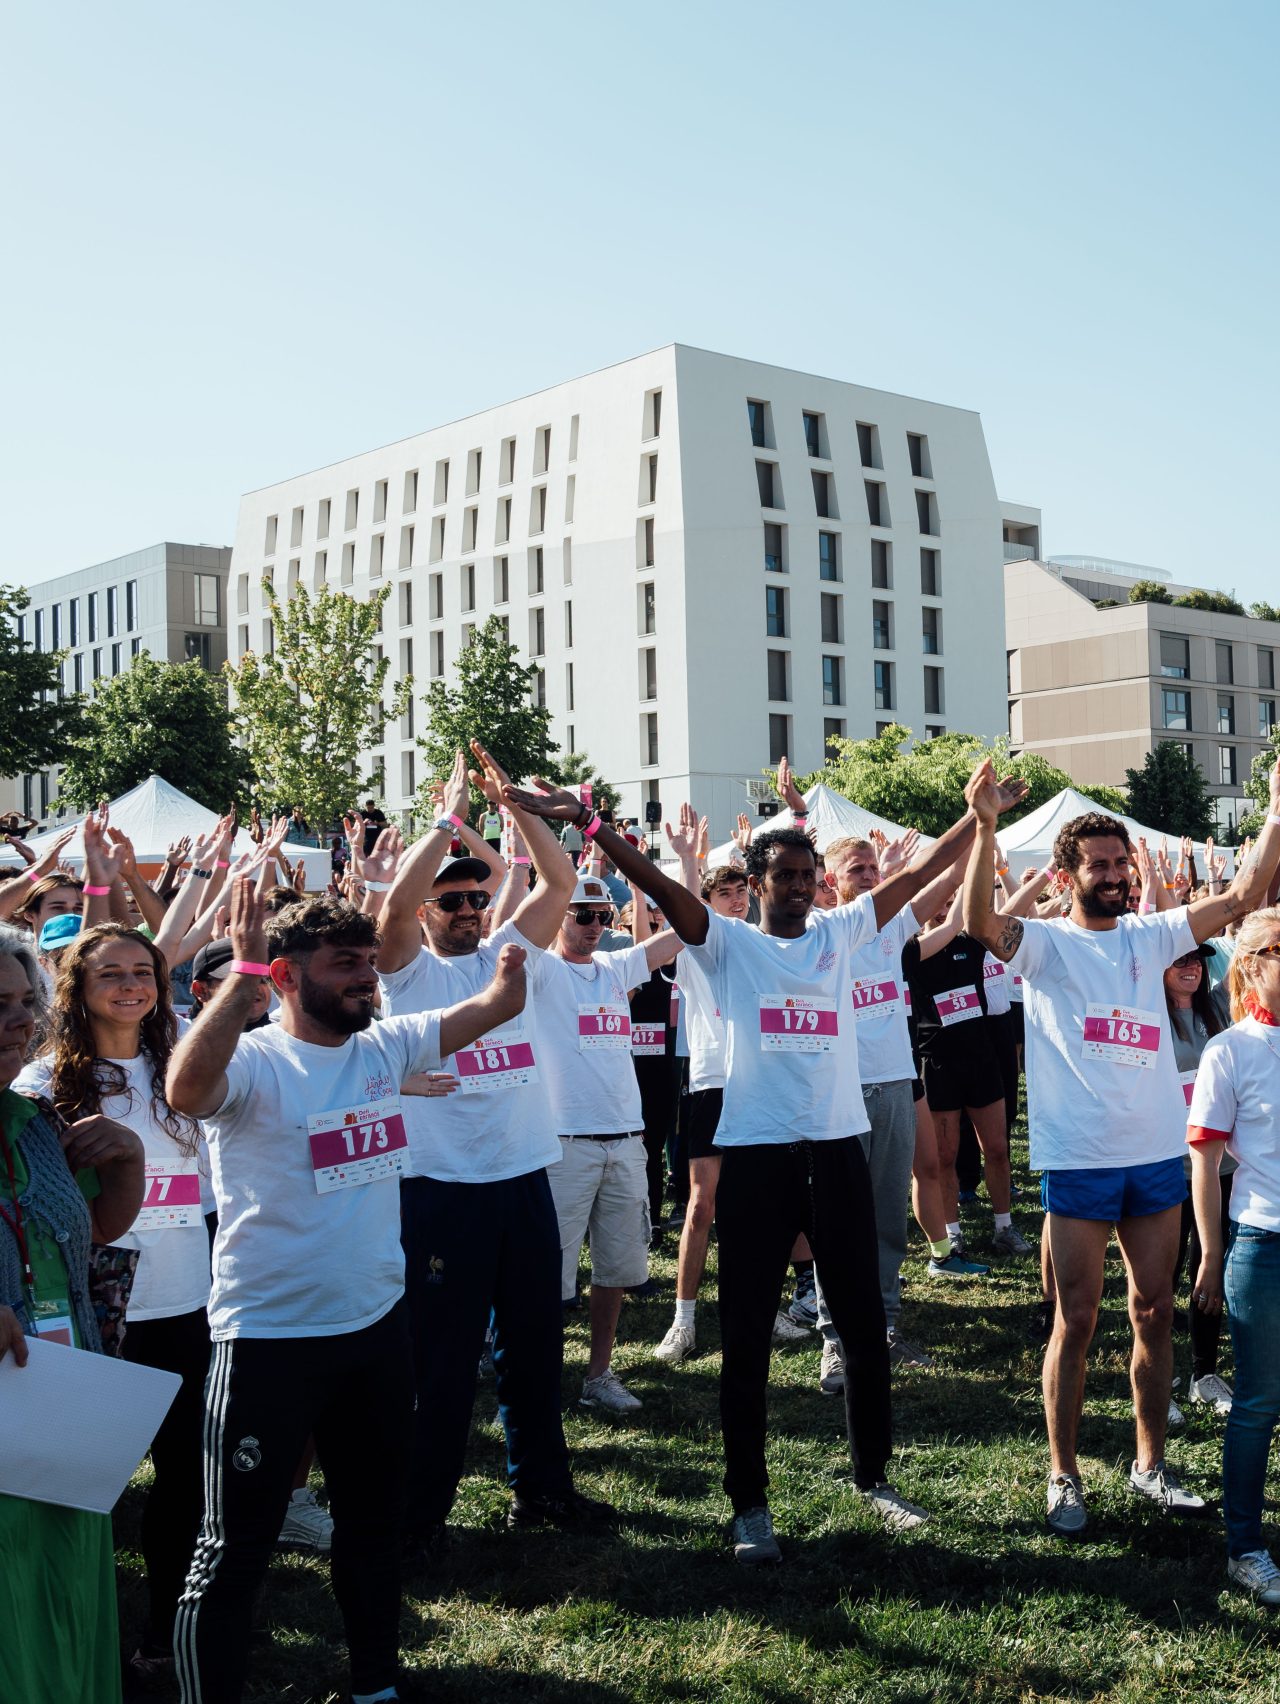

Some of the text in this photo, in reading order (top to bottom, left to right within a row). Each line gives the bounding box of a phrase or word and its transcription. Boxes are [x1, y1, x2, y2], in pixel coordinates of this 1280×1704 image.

[854, 985, 884, 1005] 176
[952, 996, 967, 1010] 58
[596, 1015, 621, 1032] 169
[781, 1010, 819, 1031] 179
[632, 1031, 655, 1043] 412
[1107, 1020, 1141, 1043] 165
[473, 1047, 511, 1071] 181
[341, 1121, 389, 1156] 173
